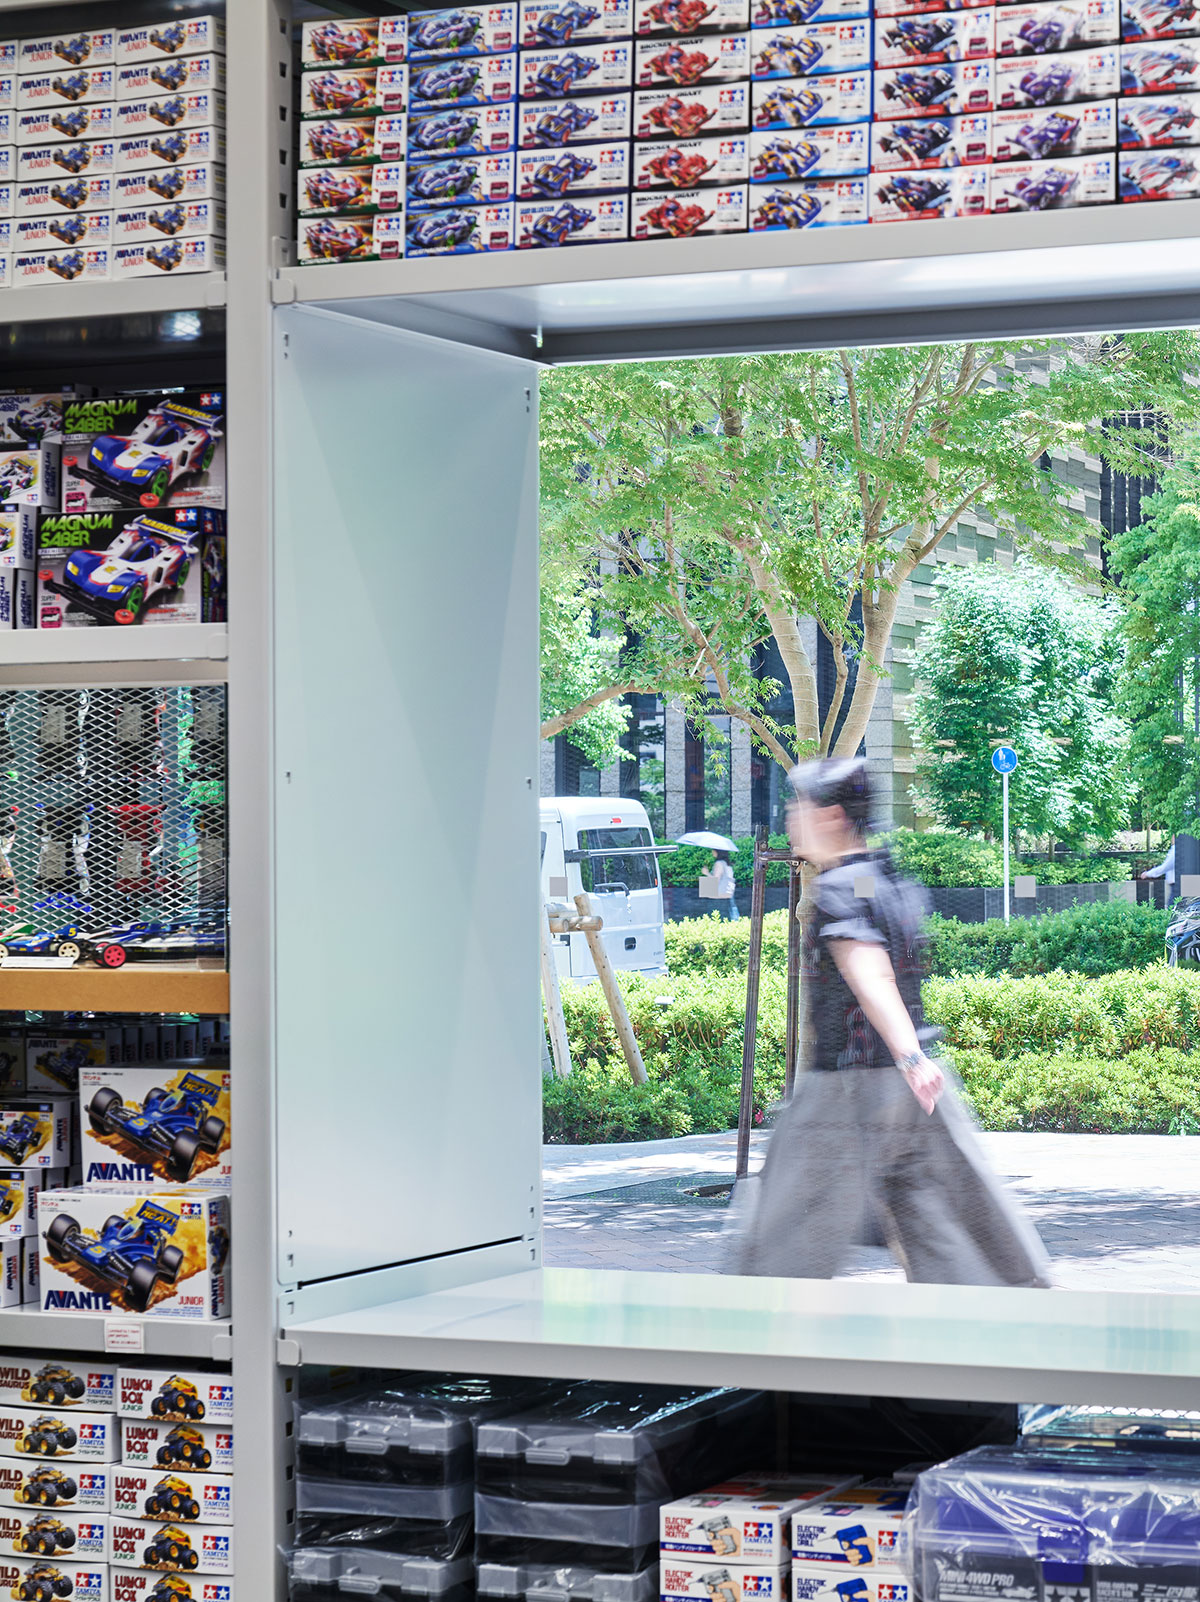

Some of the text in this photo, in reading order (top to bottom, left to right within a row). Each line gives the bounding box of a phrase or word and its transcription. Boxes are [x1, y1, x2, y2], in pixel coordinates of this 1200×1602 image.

[118, 31, 148, 44] AVANTE
[22, 42, 52, 55] AVANTE
[119, 68, 149, 82] AVANTE
[20, 78, 50, 91] AVANTE
[118, 104, 148, 117] AVANTE
[19, 115, 49, 127] AVANTE
[119, 140, 149, 154] AVANTE
[21, 150, 51, 163] AVANTE
[116, 176, 146, 190] AVANTE
[18, 186, 48, 199] AVANTE
[117, 212, 147, 226] AVANTE
[17, 222, 47, 234] AVANTE
[115, 248, 145, 262] AVANTE
[15, 257, 45, 270] AVANTE
[64, 399, 138, 417] MAGNUM
[166, 402, 212, 419] MAGNUM
[64, 416, 114, 434] SABER
[40, 514, 113, 532] MAGNUM
[141, 518, 188, 536] MAGNUM
[40, 531, 90, 548] SABER
[86, 1162, 154, 1182] AVANTE
[44, 1290, 112, 1310] AVANTE
[178, 1296, 204, 1306] JUNIOR
[121, 1377, 152, 1392] LUNCH
[121, 1392, 143, 1404] BOX
[127, 1426, 158, 1440] LUNCH
[127, 1440, 148, 1452] BOX
[116, 1476, 146, 1491] LUNCH
[79, 1488, 104, 1496] TAMIYA
[116, 1491, 137, 1503] BOX
[665, 1517, 694, 1525] ELECTRIC
[114, 1526, 144, 1541] LUNCH
[797, 1525, 826, 1534] ELECTRIC
[78, 1538, 103, 1546] TAMIYA
[114, 1541, 136, 1553] BOX
[665, 1570, 693, 1578] ELECTRIC
[940, 1570, 1014, 1586] MINI 4WD PRO
[797, 1578, 826, 1586] ELECTRIC
